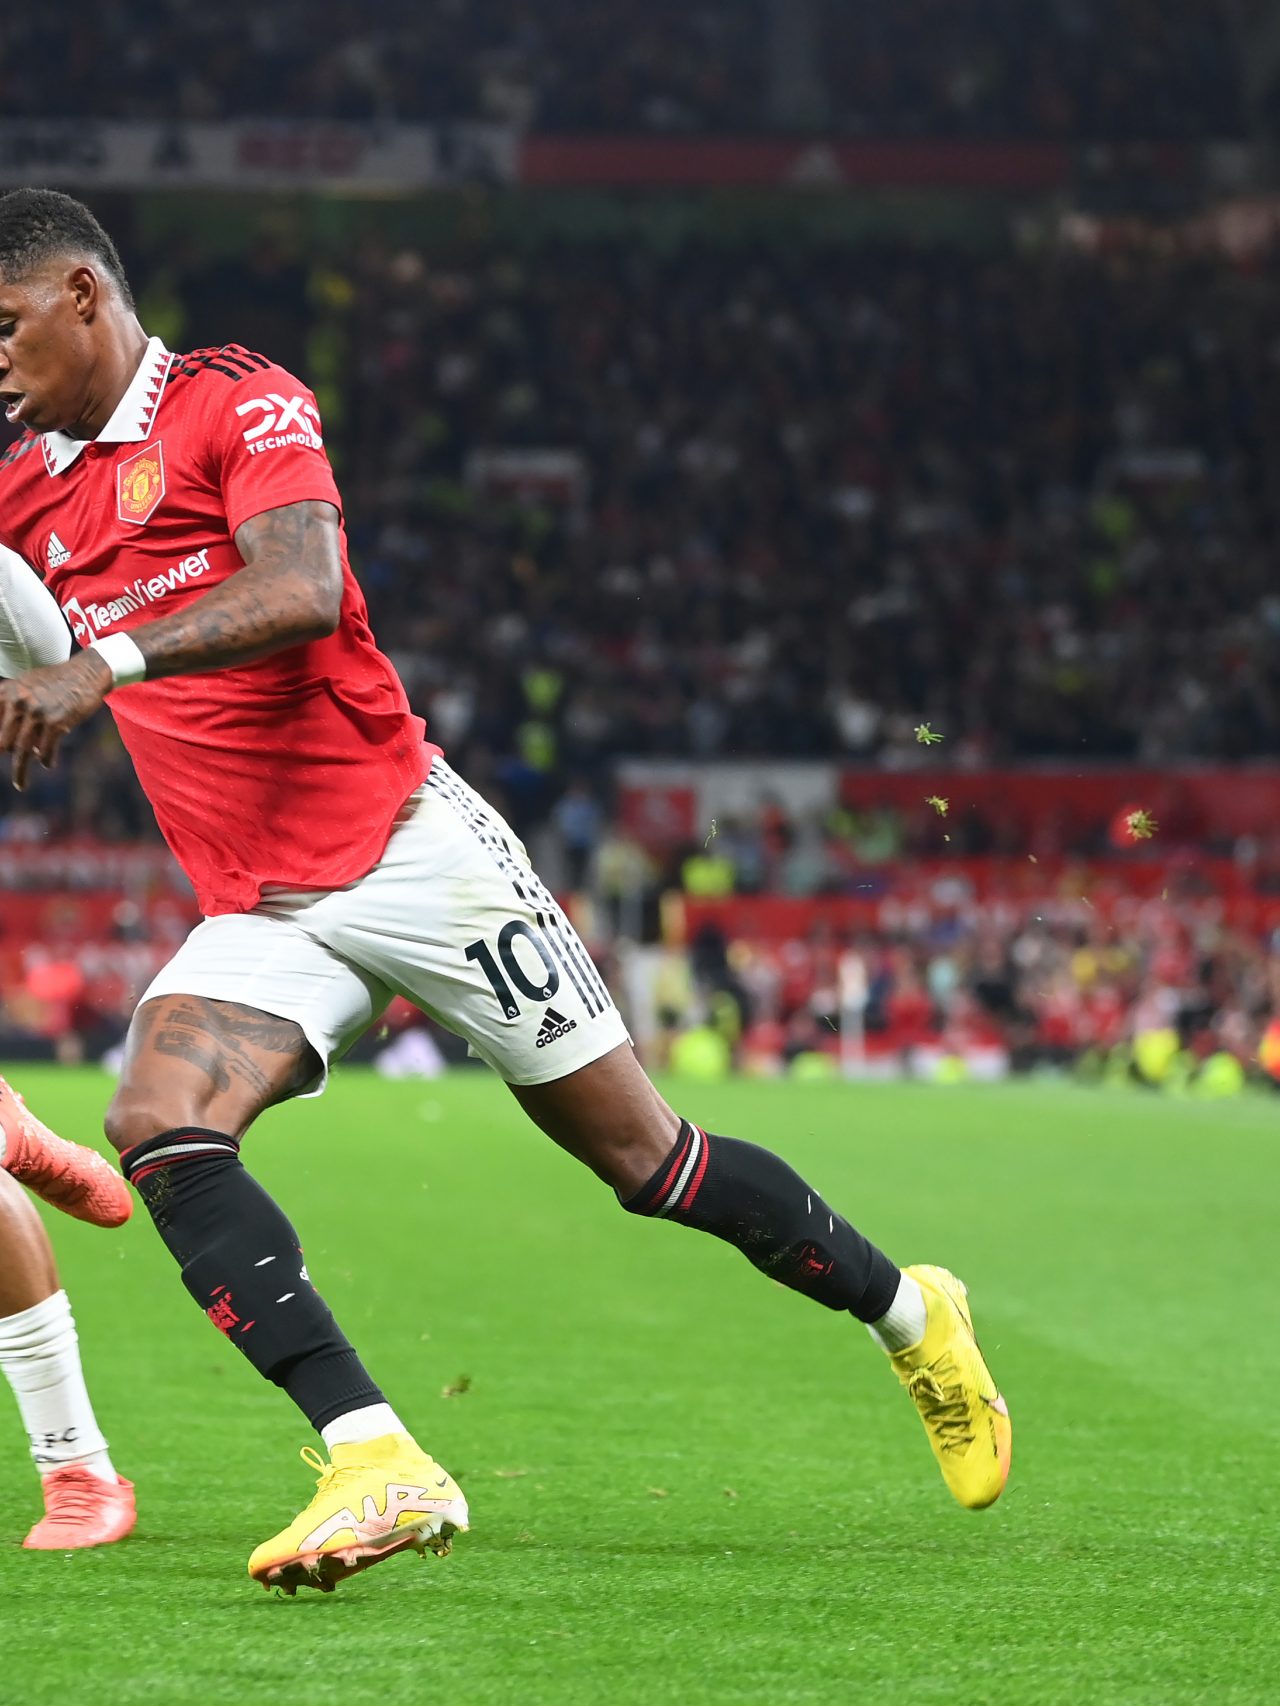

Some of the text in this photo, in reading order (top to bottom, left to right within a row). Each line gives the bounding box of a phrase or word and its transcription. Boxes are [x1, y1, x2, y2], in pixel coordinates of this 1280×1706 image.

[84, 548, 211, 631] TeamViewer
[464, 920, 560, 1021] 10
[536, 1018, 577, 1049] adidas
